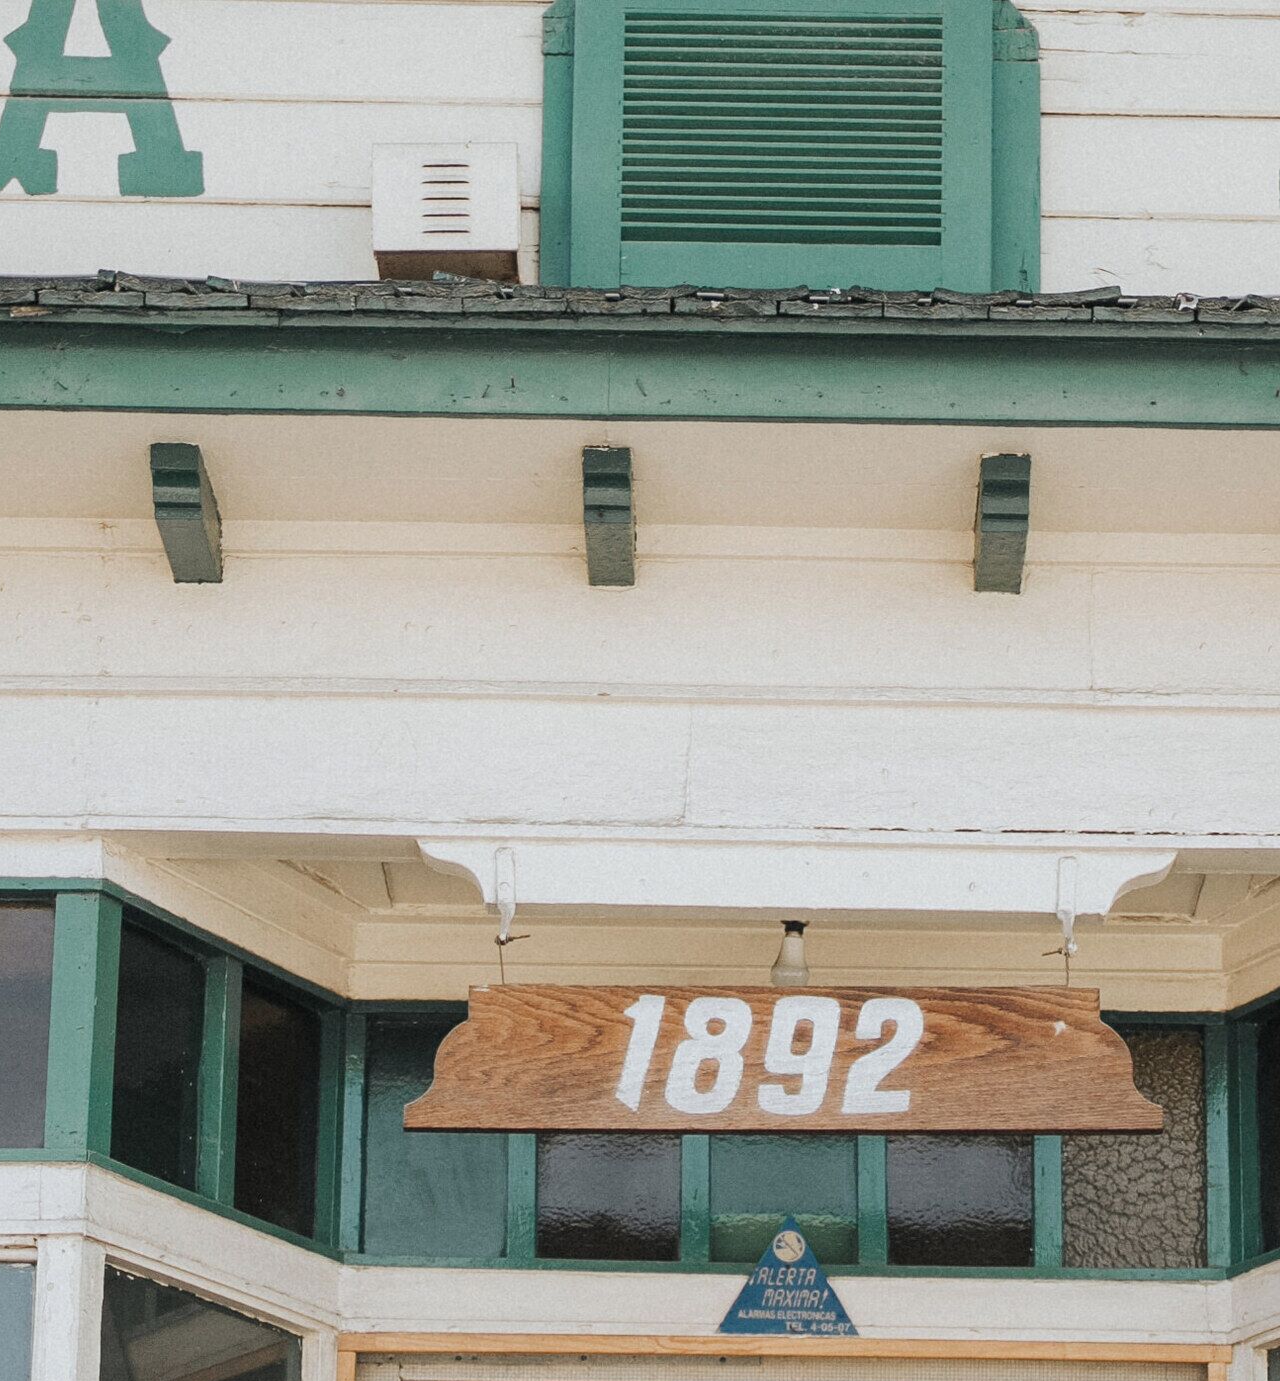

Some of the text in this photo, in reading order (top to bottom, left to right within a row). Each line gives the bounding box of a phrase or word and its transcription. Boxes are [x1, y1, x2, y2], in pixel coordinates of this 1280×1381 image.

[615, 995, 924, 1114] 1892
[762, 1289, 829, 1309] MAXIMA!
[738, 1309, 776, 1320] ALARMAS
